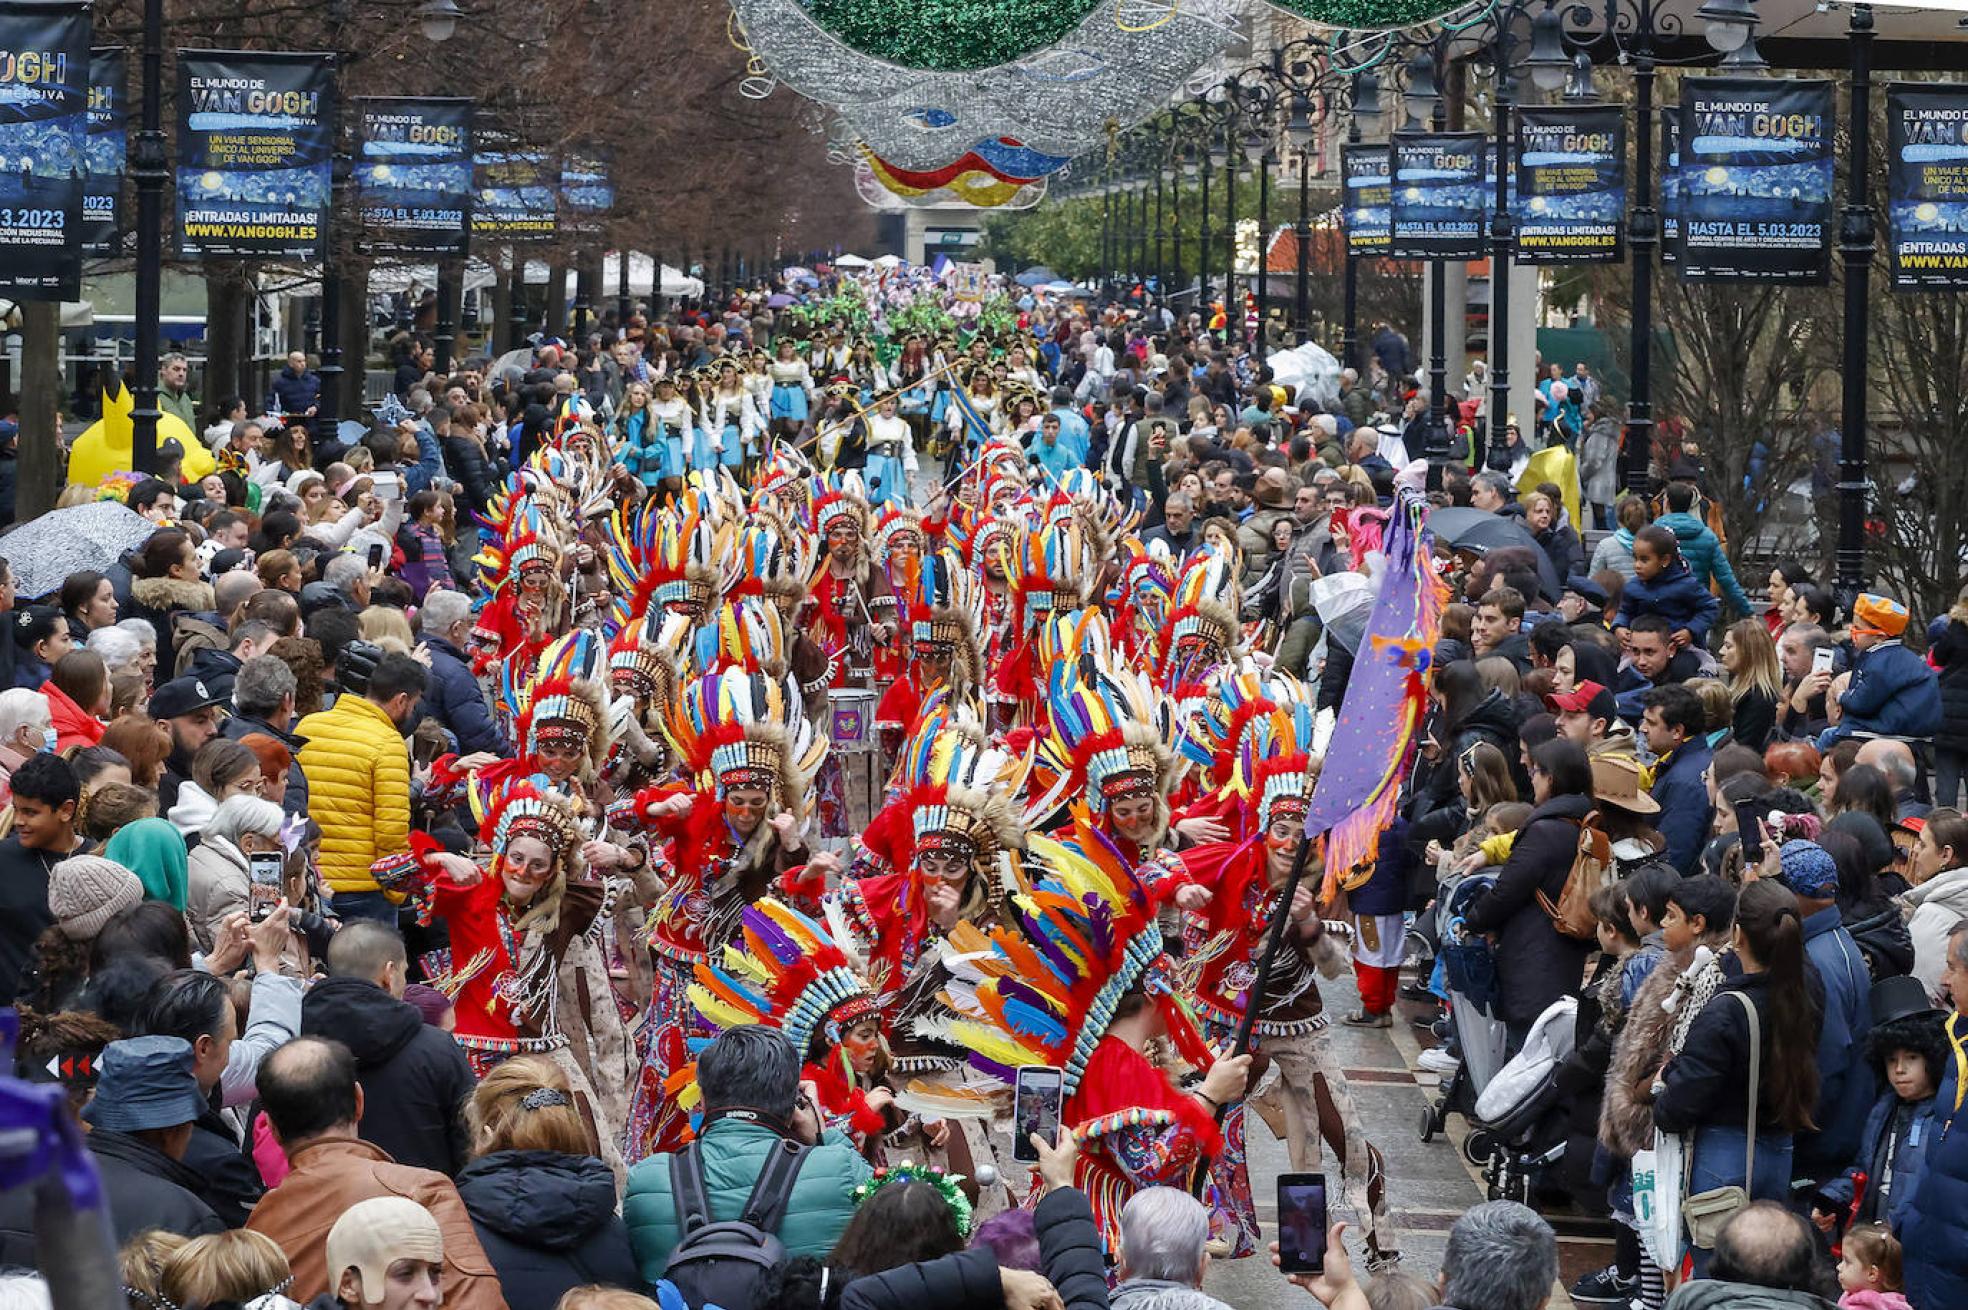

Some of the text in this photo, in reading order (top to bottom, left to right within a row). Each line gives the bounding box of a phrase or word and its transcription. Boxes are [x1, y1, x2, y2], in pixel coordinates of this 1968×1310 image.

[191, 77, 265, 90] EL MUNDO DE
[190, 89, 318, 114] VAN GOGH
[1695, 102, 1769, 113] EL MUNDO DE
[377, 115, 411, 124] MUNDO
[410, 116, 423, 124] DE
[1903, 109, 1918, 120] EL
[1919, 109, 1961, 120] MUNDO
[1522, 126, 1576, 134] EL MUNDO DE
[1695, 113, 1822, 137] VAN GOGH
[365, 124, 464, 144] VAN GOGH
[1903, 121, 1955, 144] VAN
[247, 136, 295, 146] SENSORIAL
[1522, 133, 1614, 152] VAN GOGH
[238, 146, 250, 154] AL
[251, 146, 296, 155] UNIVERSO
[1408, 147, 1435, 155] MUNDO
[223, 154, 281, 164] DE VAN GOGH
[1398, 155, 1432, 169] VAN
[1434, 155, 1478, 169] GOGH
[1923, 167, 1937, 175] UN
[1937, 167, 1961, 175] VIAJE
[1953, 176, 1966, 185] AL
[1937, 185, 1951, 194] DE
[184, 210, 318, 225] ¡ENTRADAS LIMITADAS!
[397, 208, 410, 219] EL
[412, 208, 463, 220] 5.03.2023
[184, 224, 318, 239] WWW.VANGOGH.ES
[1395, 221, 1424, 231] HASTA
[1424, 222, 1435, 232] EL
[1520, 226, 1616, 237] ¡ENTRADAS LIMITADAS!
[1688, 222, 1734, 235] HASTA
[1737, 222, 1755, 236] EL
[1758, 223, 1822, 237] 5.03.2023
[1520, 236, 1616, 246] WWW.VANGOGH.ES
[1898, 241, 1966, 255] ¡ENTRADAS
[726, 1110, 757, 1120] Canon
